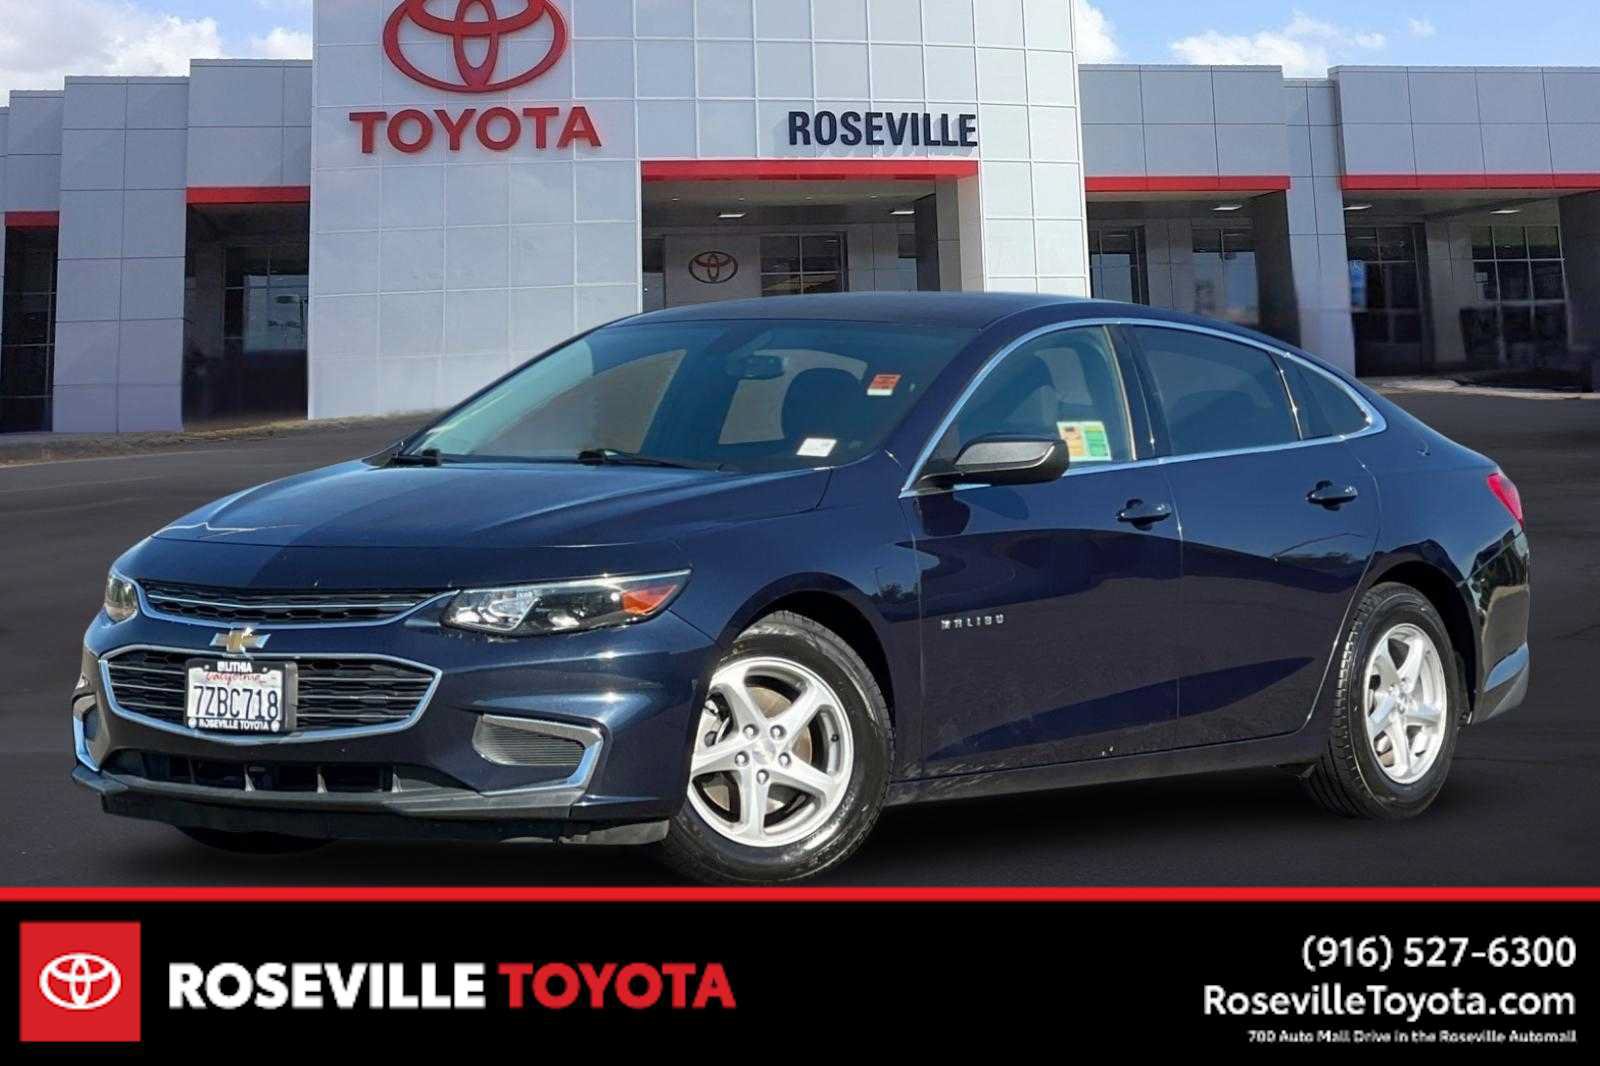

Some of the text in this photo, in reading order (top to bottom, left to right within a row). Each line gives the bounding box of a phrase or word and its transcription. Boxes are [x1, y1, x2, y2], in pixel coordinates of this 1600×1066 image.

[349, 106, 602, 154] TOYOTA
[788, 111, 978, 147] ROSEVILLE
[940, 614, 1004, 629] MALIBU
[193, 685, 279, 720] 7ZBC718
[199, 718, 269, 730] ROSEVILLE TOYOTA
